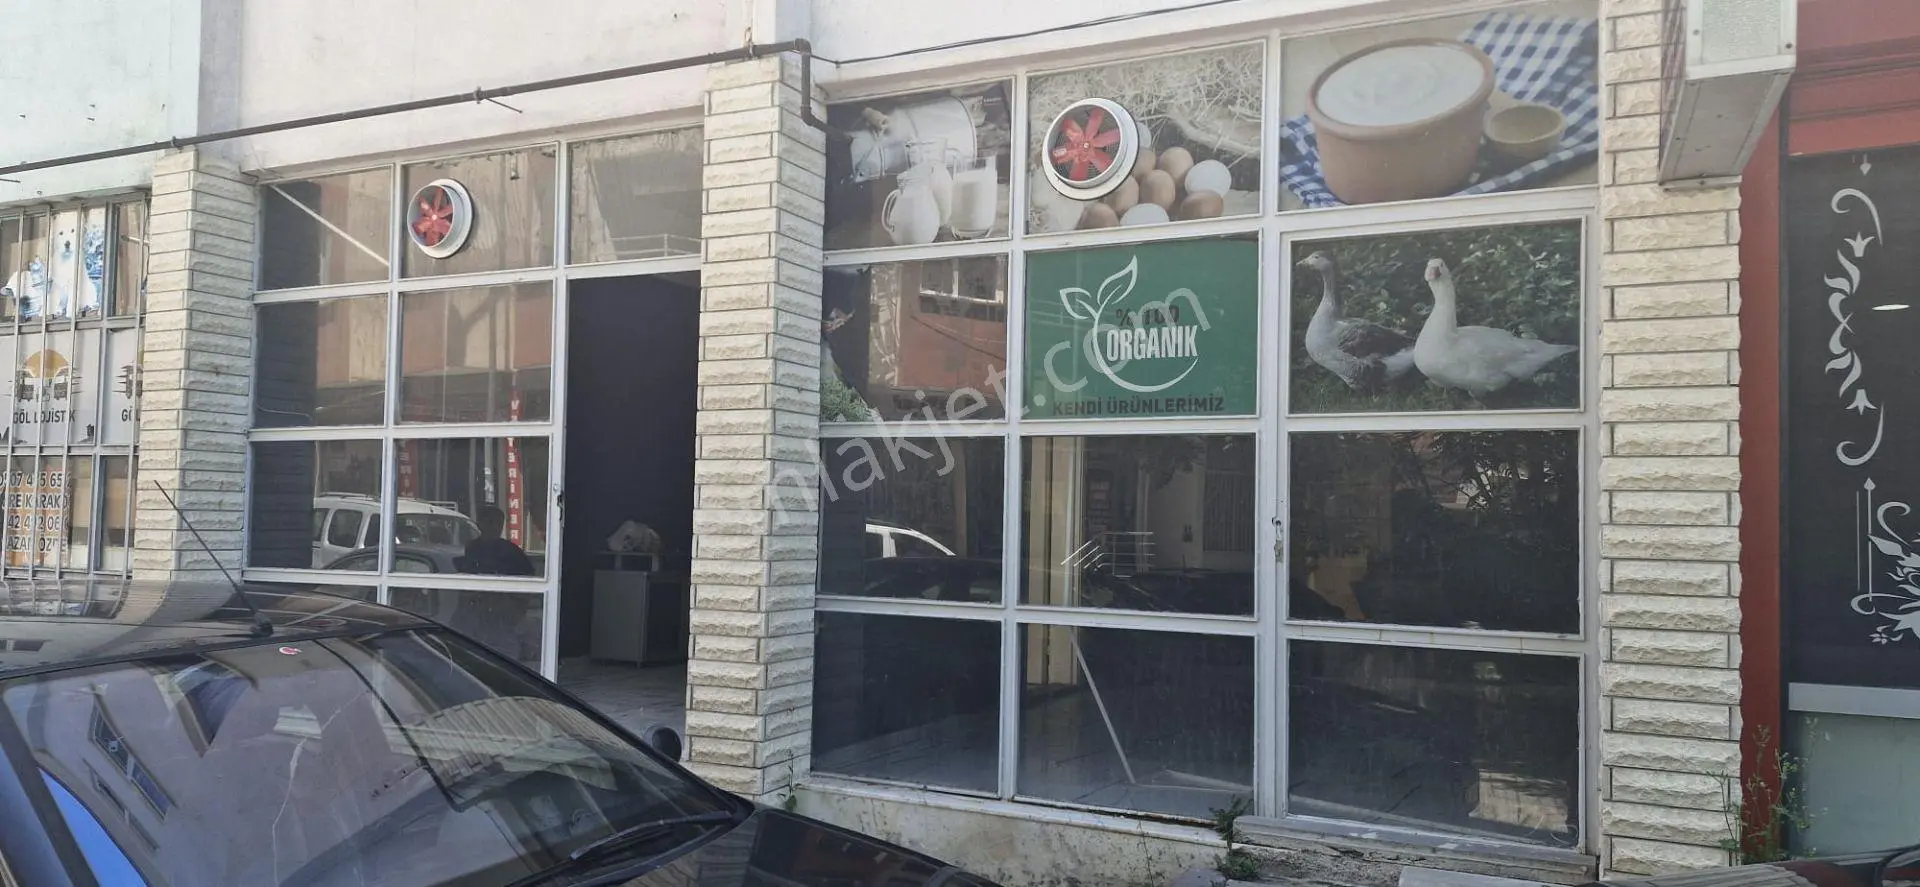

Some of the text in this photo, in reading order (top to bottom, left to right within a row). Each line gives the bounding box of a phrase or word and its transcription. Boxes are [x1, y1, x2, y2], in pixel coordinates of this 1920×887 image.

[1106, 325, 1198, 361] ORGANIK
[1052, 394, 1225, 416] KENDİ ÜRÜNLERİMİZ
[13, 407, 75, 424] GÖL LOJİSTK
[26, 472, 46, 487] 45
